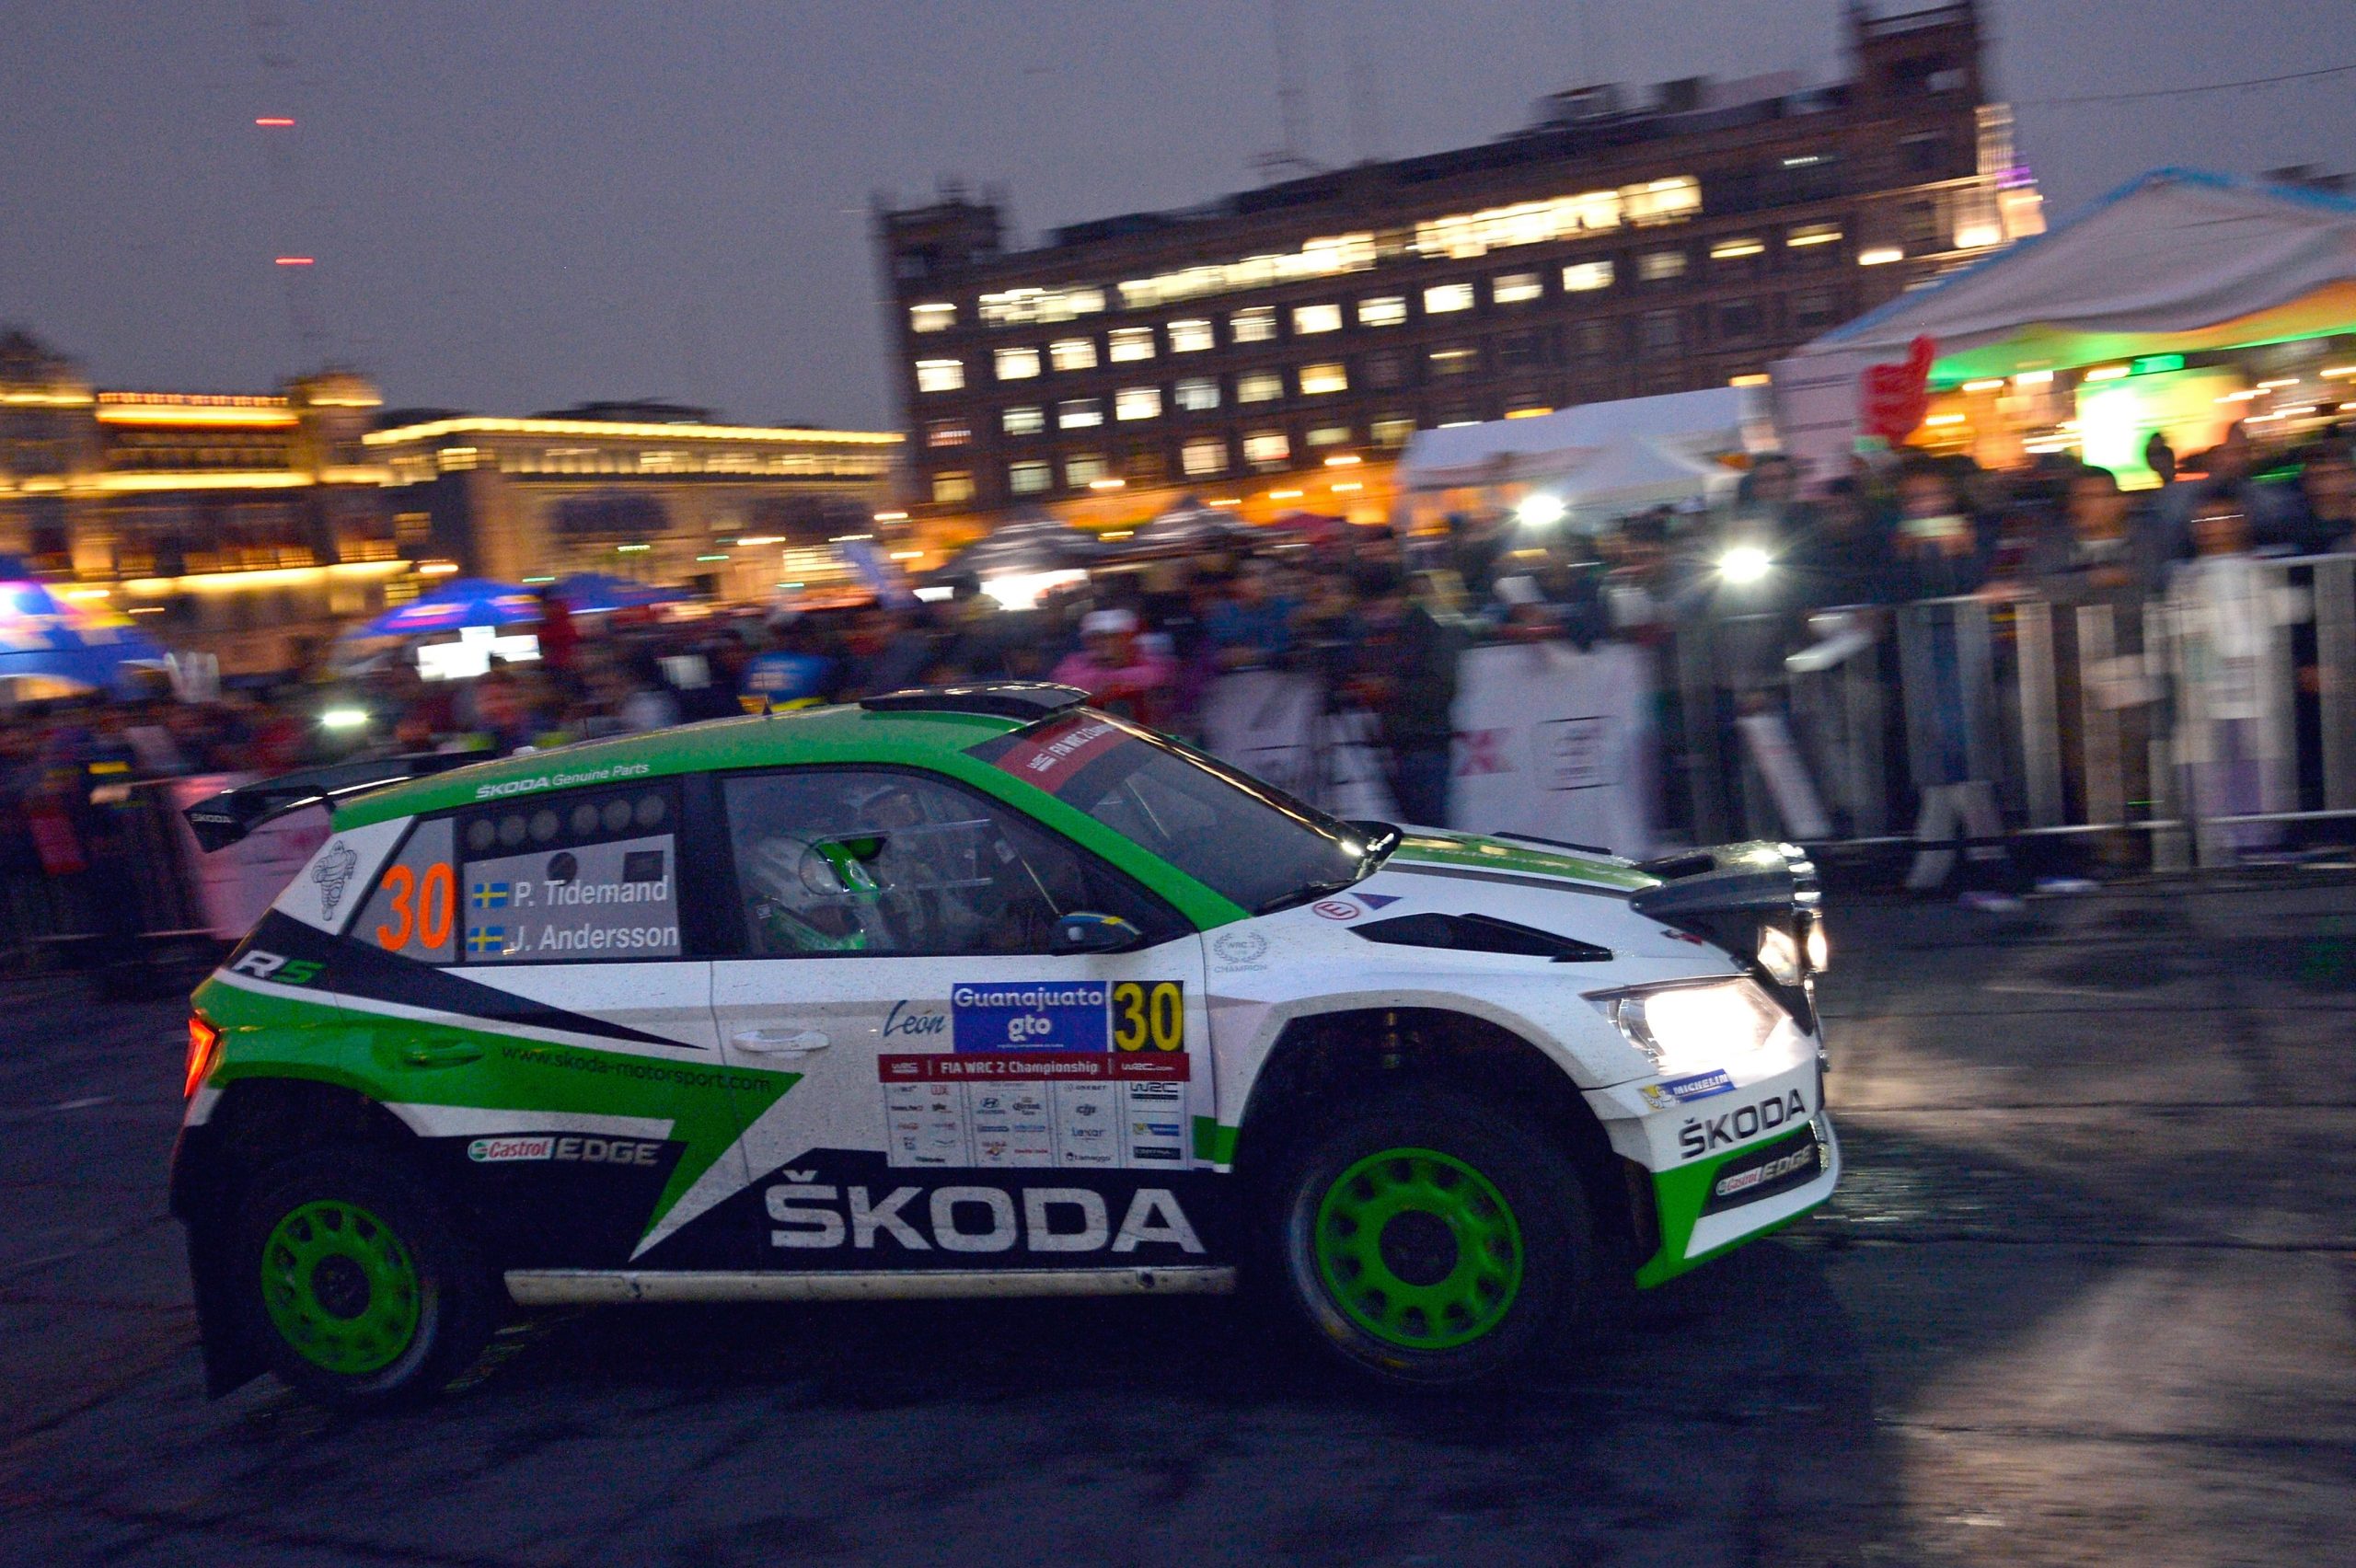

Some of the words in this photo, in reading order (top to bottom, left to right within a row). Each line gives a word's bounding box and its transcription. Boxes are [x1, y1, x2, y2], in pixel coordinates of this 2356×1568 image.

[476, 776, 549, 799] ŠKODA
[552, 769, 609, 786] Genuine
[612, 763, 650, 777] Parts
[376, 862, 455, 951] 30
[514, 881, 534, 907] P.
[545, 875, 668, 906] Tidemand
[508, 926, 530, 952] J.
[538, 923, 678, 951] Andersson
[232, 951, 326, 985] R5
[1214, 964, 1267, 973] CHAMPION
[953, 987, 1103, 1011] Guanajuato
[884, 999, 946, 1037] León
[1008, 1014, 1052, 1042] gto
[1114, 982, 1184, 1052] 30
[502, 1045, 771, 1091] www.skoda-motorsport.com
[941, 1062, 963, 1074] FIA
[965, 1062, 994, 1074] WRC
[997, 1062, 1006, 1074] 2
[1008, 1061, 1099, 1075] Championship
[1672, 1072, 1728, 1095] MICHELIN
[1130, 1081, 1178, 1093] WRC
[1071, 1127, 1103, 1137] Lexar
[1679, 1089, 1806, 1159] ŠKODA
[490, 1140, 548, 1159] Castrol
[554, 1137, 663, 1166] EDGE
[1761, 1147, 1816, 1181] EDGE
[768, 1169, 1207, 1256] ŠKODA
